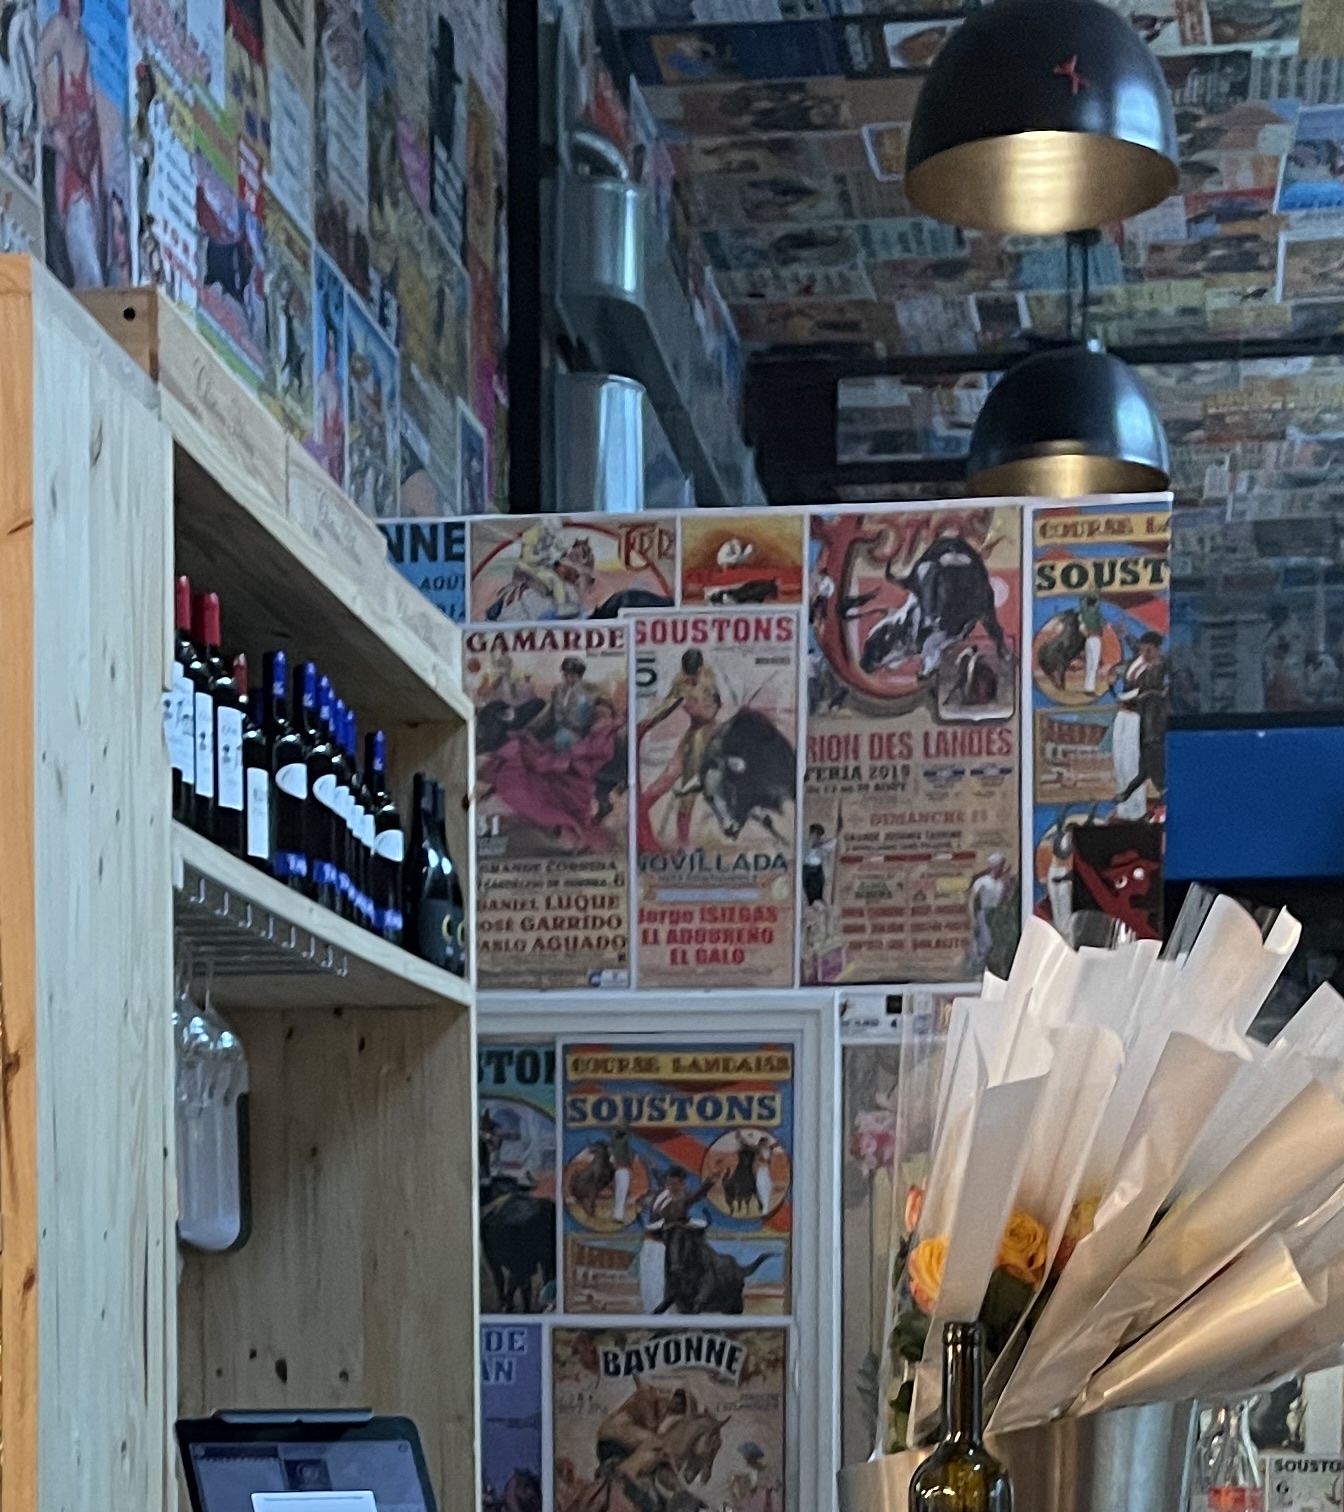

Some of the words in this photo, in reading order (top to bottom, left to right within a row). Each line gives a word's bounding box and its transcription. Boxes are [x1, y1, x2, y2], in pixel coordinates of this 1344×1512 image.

[465, 627, 626, 653] GAMARDE
[635, 616, 795, 646] SOUSTONS
[869, 730, 913, 761] DES
[922, 728, 1013, 759] LANDES
[544, 894, 620, 912] LUQUE
[520, 914, 623, 932] GARRIDO
[571, 1055, 660, 1076] COURSE
[672, 1053, 791, 1074] LANDAISE
[567, 1094, 778, 1124] SOUSTONS
[601, 1332, 746, 1378] BAYONNE
